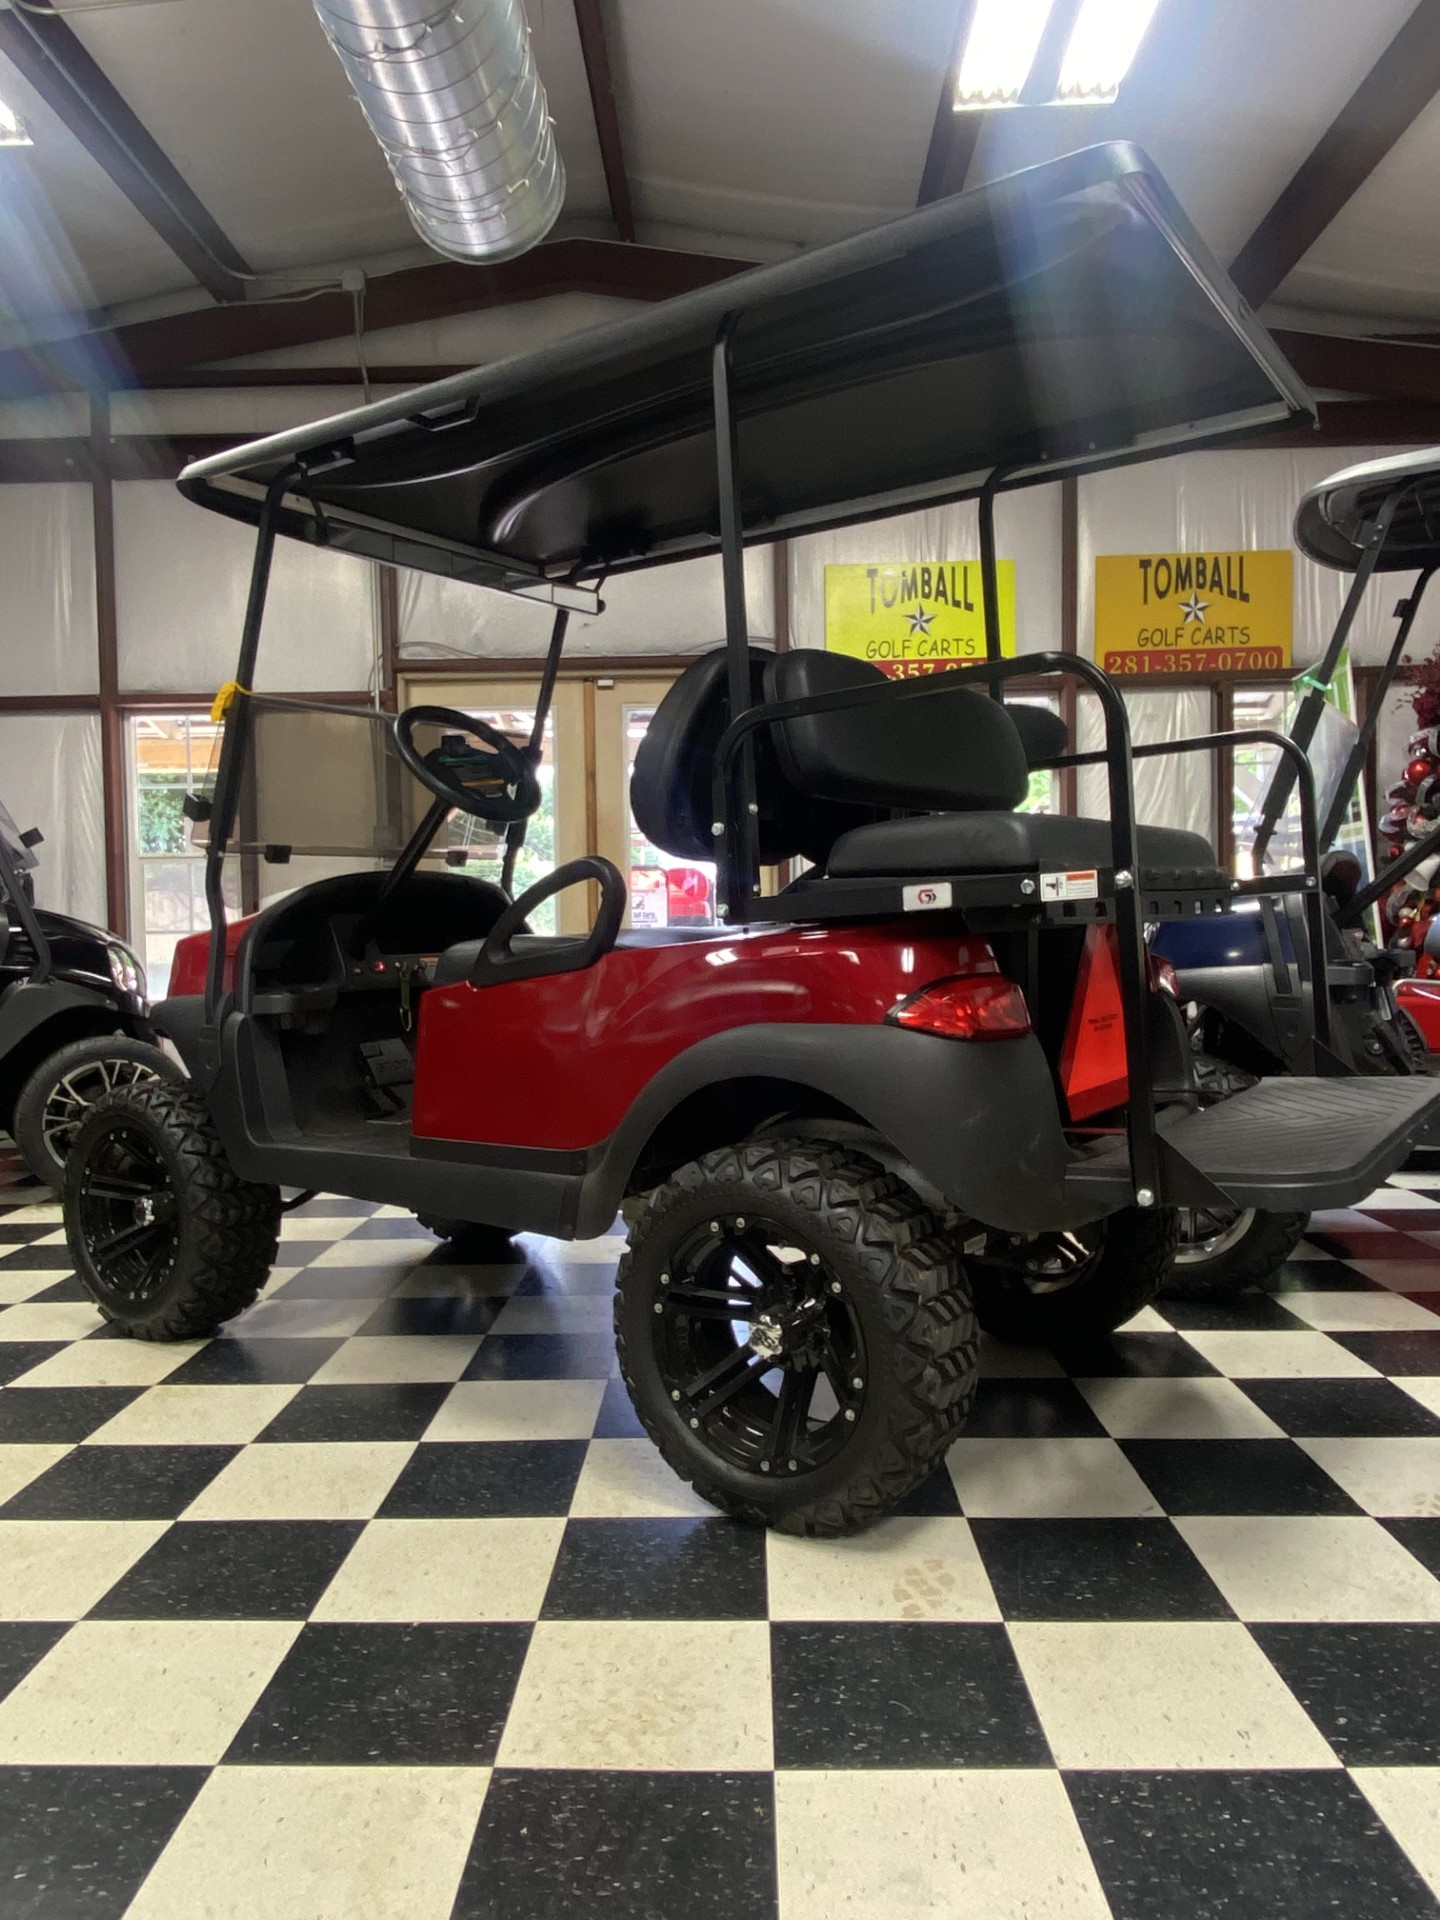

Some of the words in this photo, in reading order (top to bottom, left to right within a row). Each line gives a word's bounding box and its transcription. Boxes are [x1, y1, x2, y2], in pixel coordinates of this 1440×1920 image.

[866, 565, 974, 614] TOMBALL
[1138, 555, 1250, 605] TOMBALL
[1137, 627, 1185, 647] GOLF
[1191, 626, 1251, 645] CARTS
[866, 640, 912, 659] GOLF
[917, 638, 976, 657] CARTS
[1109, 651, 1279, 674] 281-357-0700
